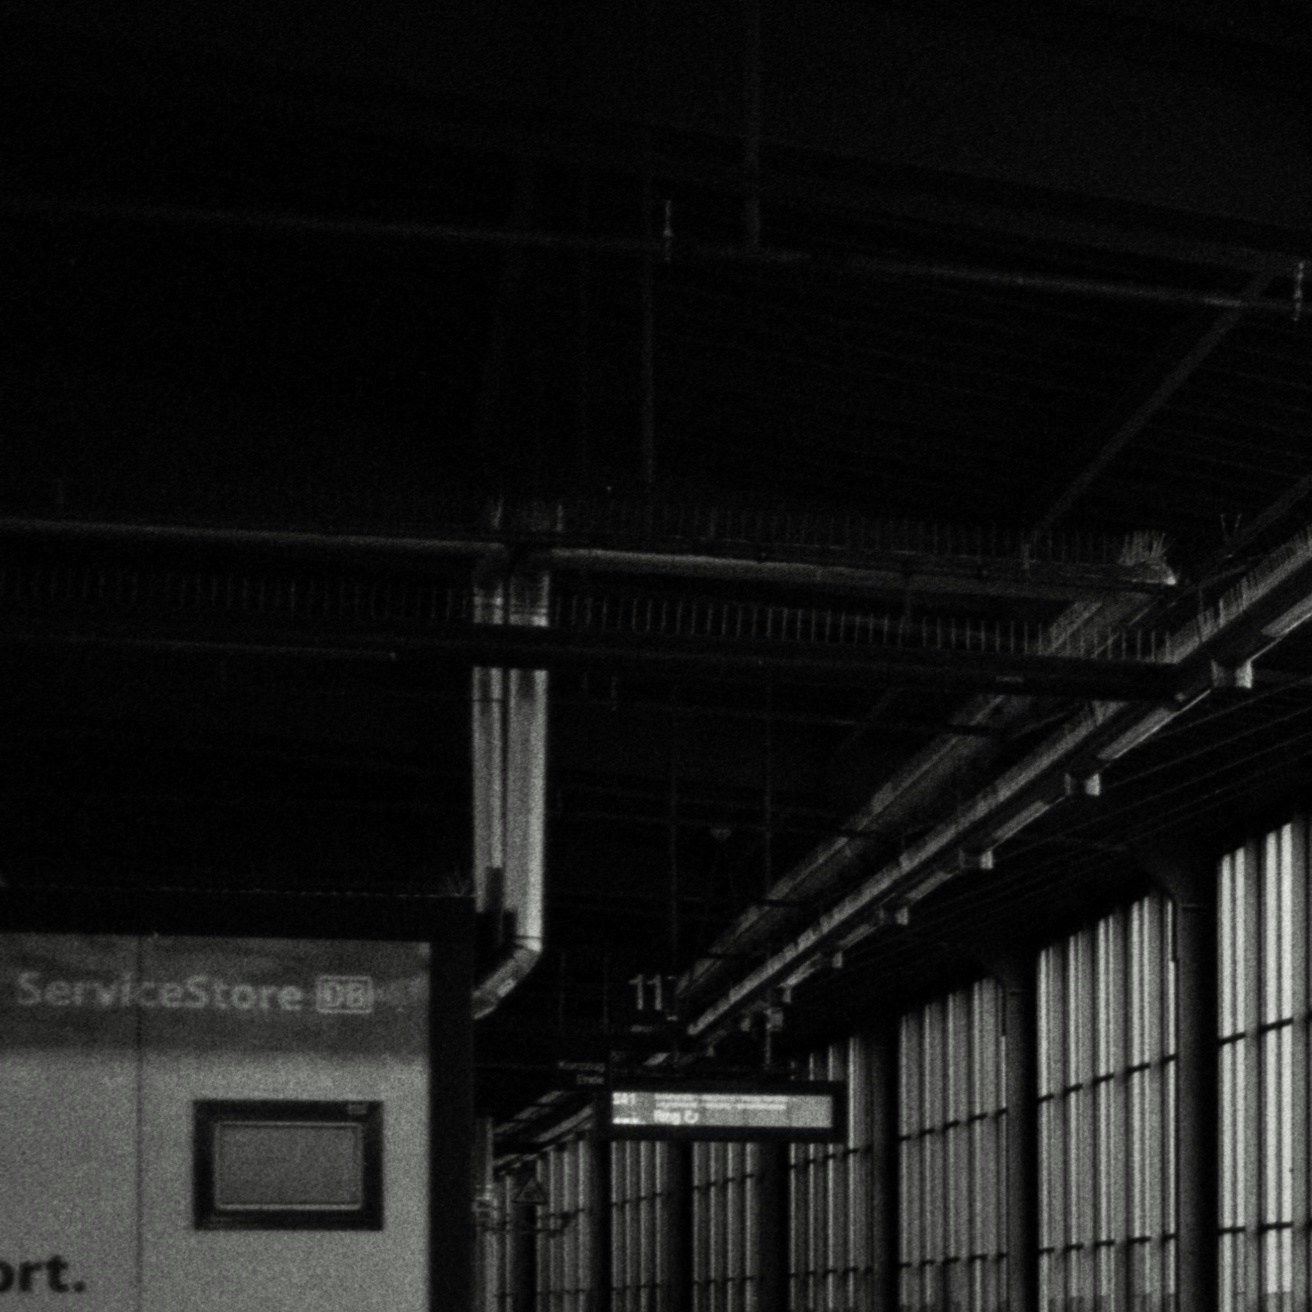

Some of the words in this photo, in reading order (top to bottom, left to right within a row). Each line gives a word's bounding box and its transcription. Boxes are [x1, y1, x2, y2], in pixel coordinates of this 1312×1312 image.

[16, 971, 303, 1010] ServiceStore
[322, 979, 369, 1010] DB
[628, 974, 662, 1010] 11
